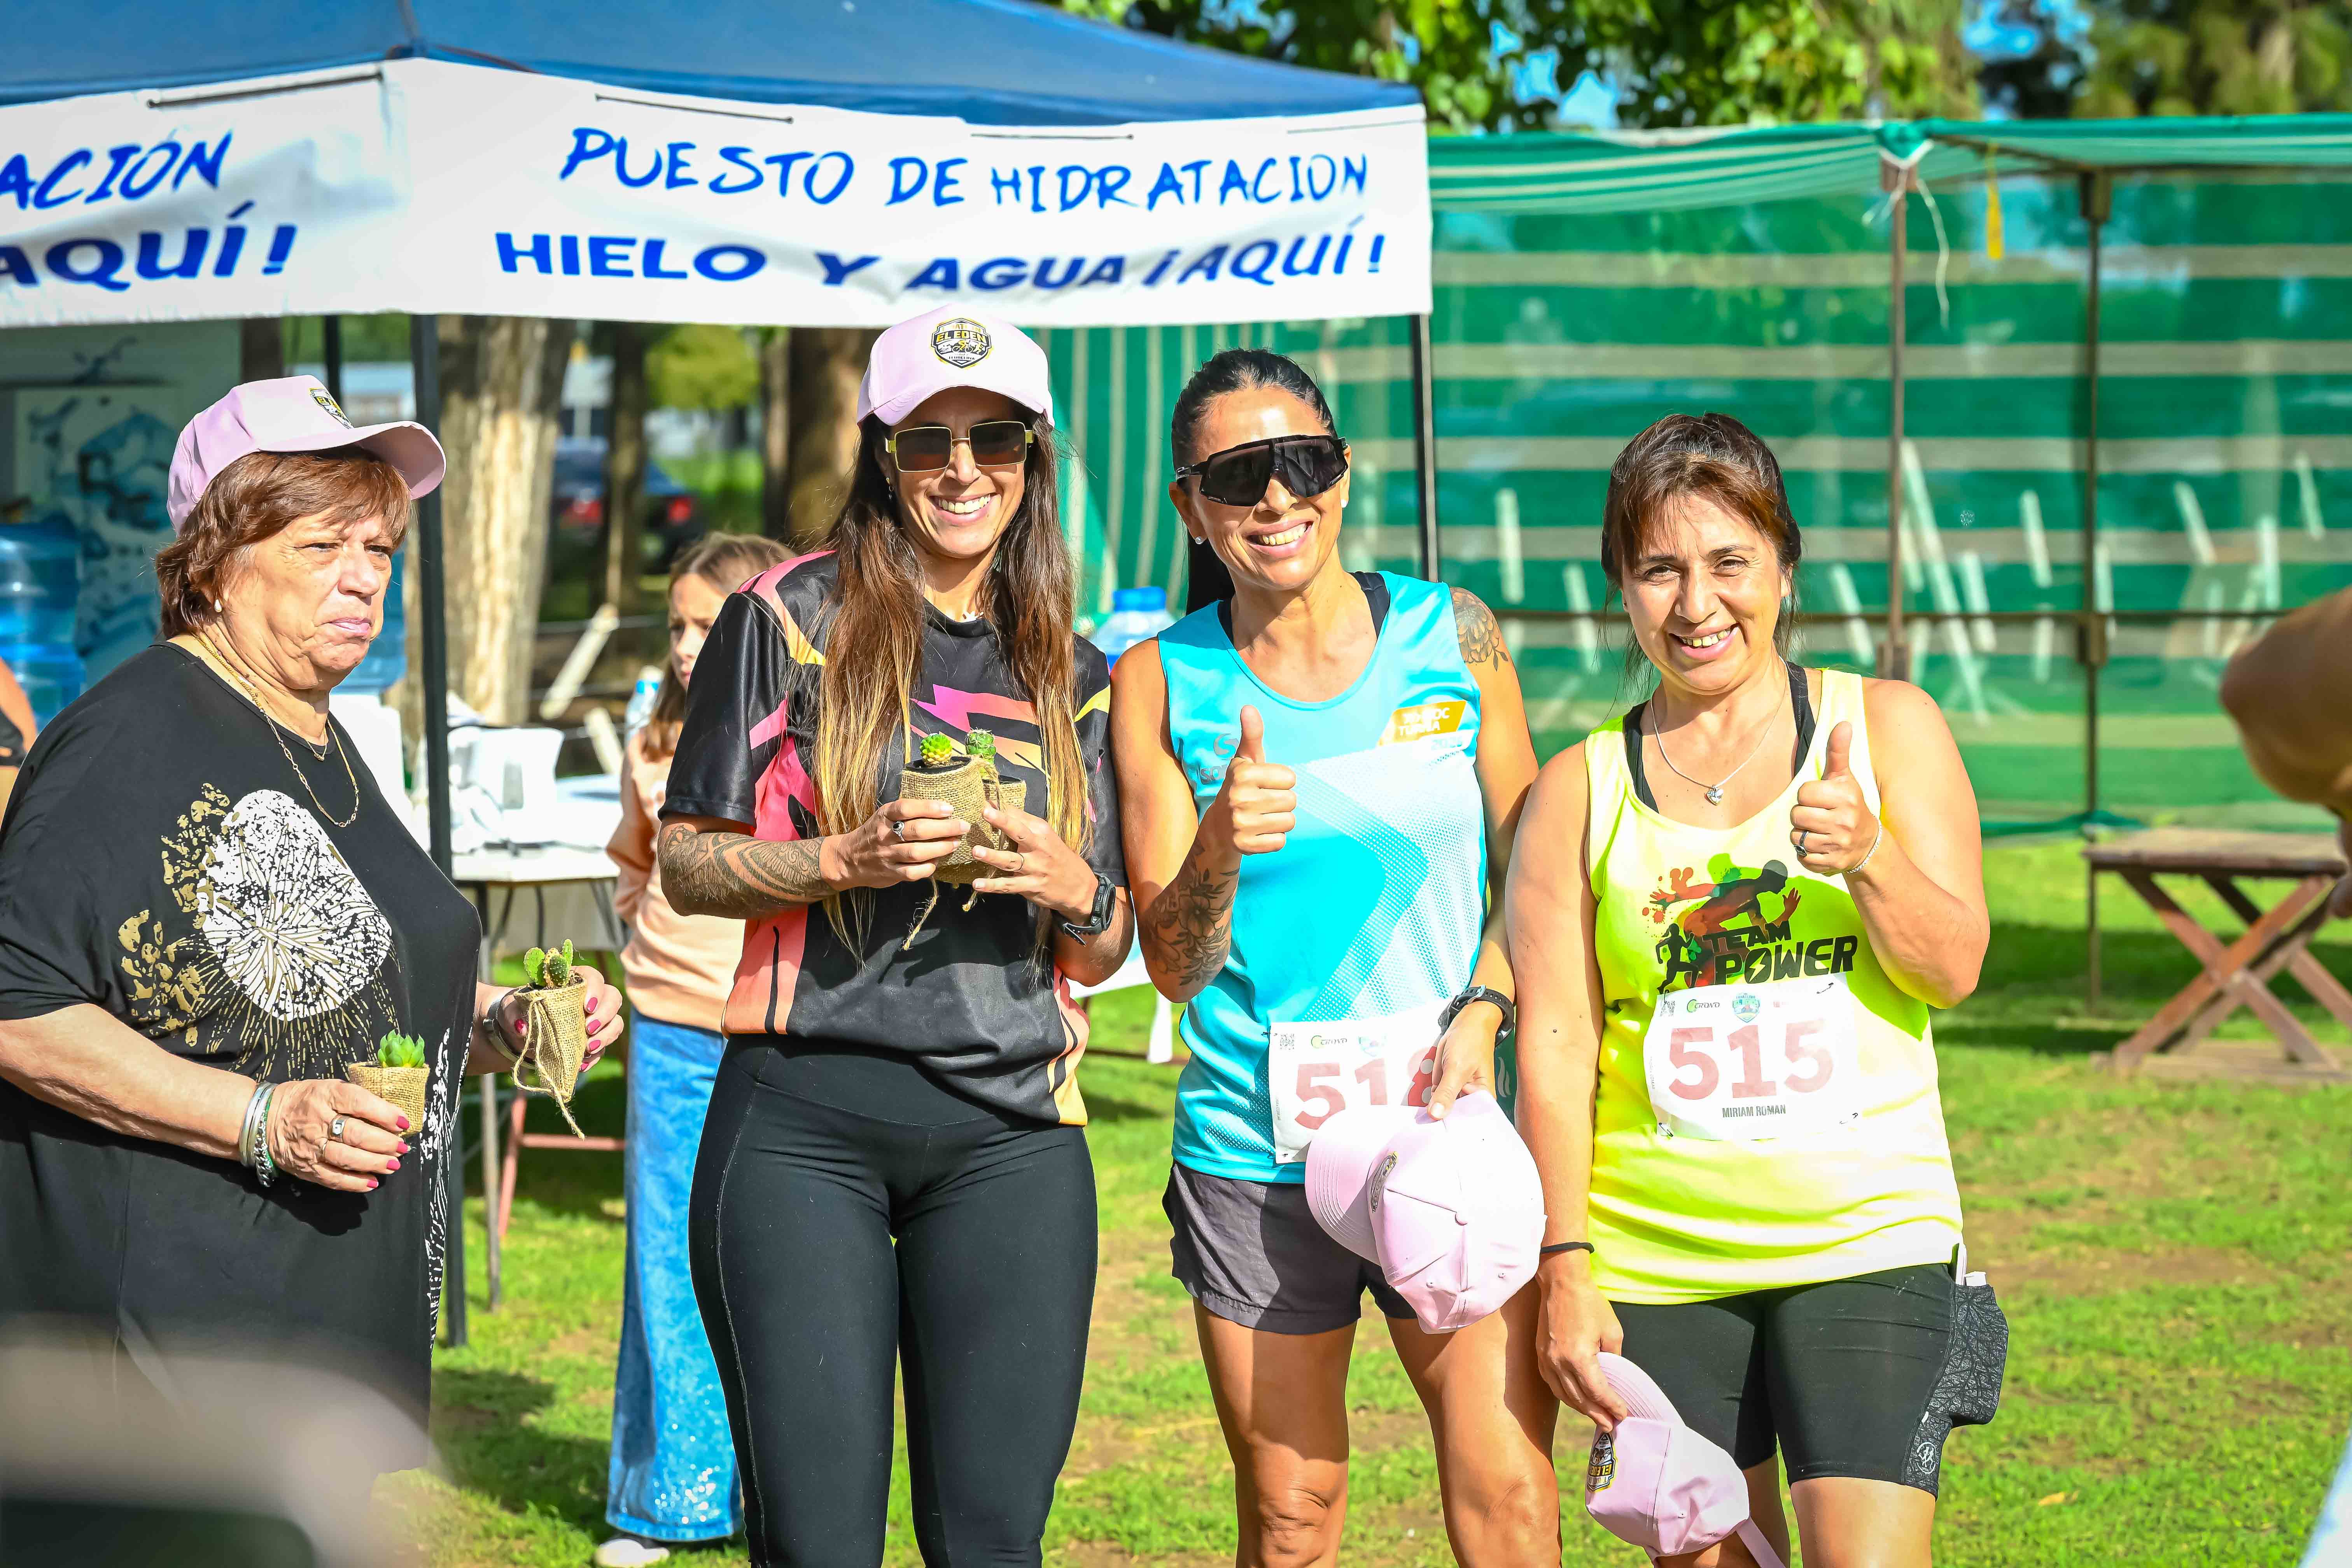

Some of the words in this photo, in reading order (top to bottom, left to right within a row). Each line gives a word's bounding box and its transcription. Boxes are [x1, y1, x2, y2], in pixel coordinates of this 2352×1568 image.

[560, 127, 855, 205] PUESTO
[886, 157, 968, 207] DE
[495, 232, 767, 282] HIELO
[815, 251, 881, 286] Y
[905, 255, 1126, 292] AGUA
[936, 331, 951, 343] EL
[953, 330, 987, 345] EDEN
[1702, 920, 1792, 955] TEAM
[1715, 935, 1858, 985] POWER
[1669, 1019, 1833, 1100] 515
[1722, 1106, 1754, 1118] MIRIAM
[1756, 1104, 1786, 1116] ROMAN
